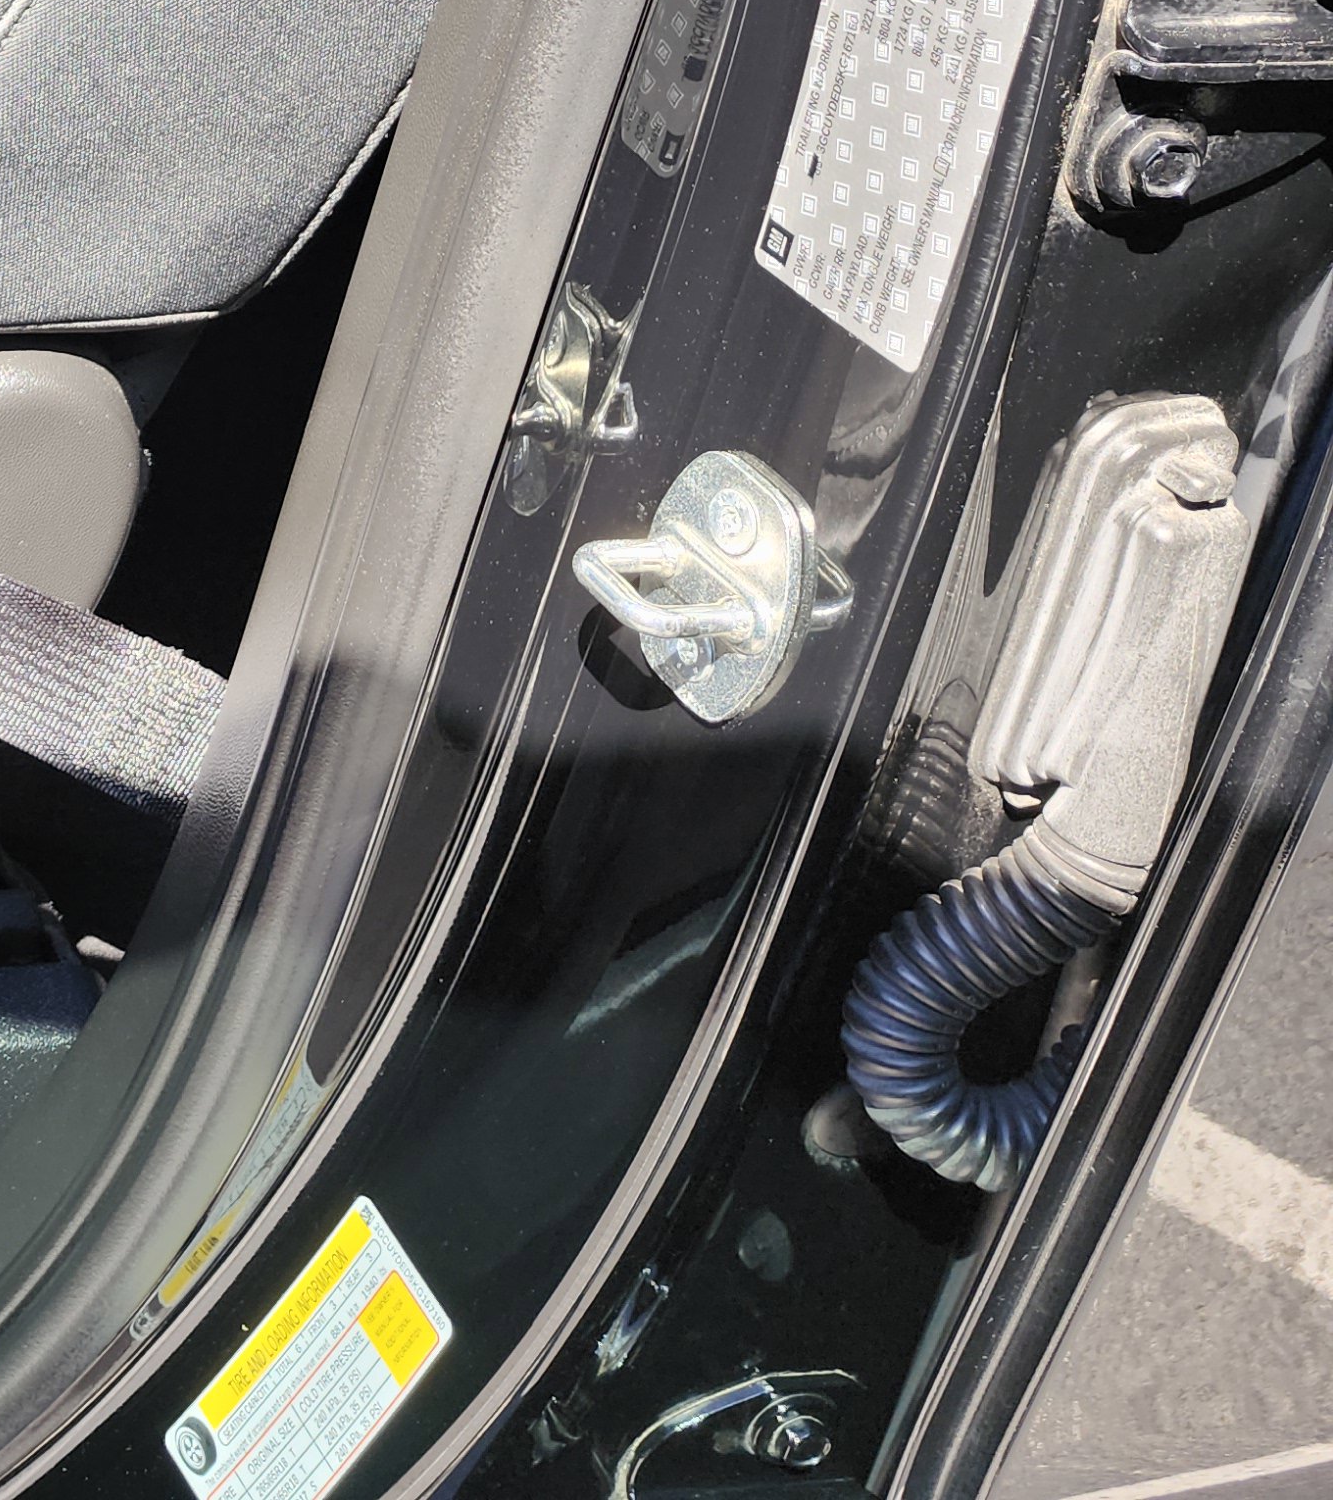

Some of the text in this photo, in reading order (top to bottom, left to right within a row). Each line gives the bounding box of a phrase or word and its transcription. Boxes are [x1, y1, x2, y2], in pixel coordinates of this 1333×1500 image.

[859, 6, 876, 36] 3221
[875, 15, 892, 45] 6804
[892, 24, 909, 55] 1724
[927, 43, 944, 69] 435
[955, 26, 988, 102] INFORMATION
[794, 88, 820, 158] TRAILERING
[811, 9, 841, 90] INFORMATION
[947, 99, 967, 134] MORE
[940, 130, 957, 158] FOR
[921, 173, 945, 221] MANUAL
[765, 224, 785, 256] GM
[807, 249, 826, 290] GCWR:
[836, 230, 869, 313] MAX PAYLOAD:
[852, 202, 898, 325] MAX TONGUE WEIGHT:
[899, 264, 916, 289] SEE
[868, 300, 887, 336] CURB
[343, 1267, 362, 1290] REAR
[227, 1245, 350, 1398] TIRE AND LOADING INFORMATION
[306, 1311, 328, 1338] FRONT
[328, 1318, 346, 1340] 881
[359, 1274, 380, 1300] 1940
[274, 1353, 294, 1378] TOTAL
[297, 1329, 366, 1415] COLD TIRE PRESSURE
[221, 1381, 270, 1440] SEATING CAPACITY
[312, 1408, 329, 1429] 240
[337, 1381, 350, 1398] 35
[346, 1365, 362, 1385] PSI
[323, 1425, 339, 1446] 240
[347, 1398, 361, 1414] 35
[357, 1382, 373, 1403] PSI
[246, 1433, 281, 1476] ORIGINAL
[276, 1416, 296, 1441] SIZE
[333, 1441, 350, 1463] 240
[358, 1414, 371, 1431] 35
[367, 1399, 383, 1420] PSI
